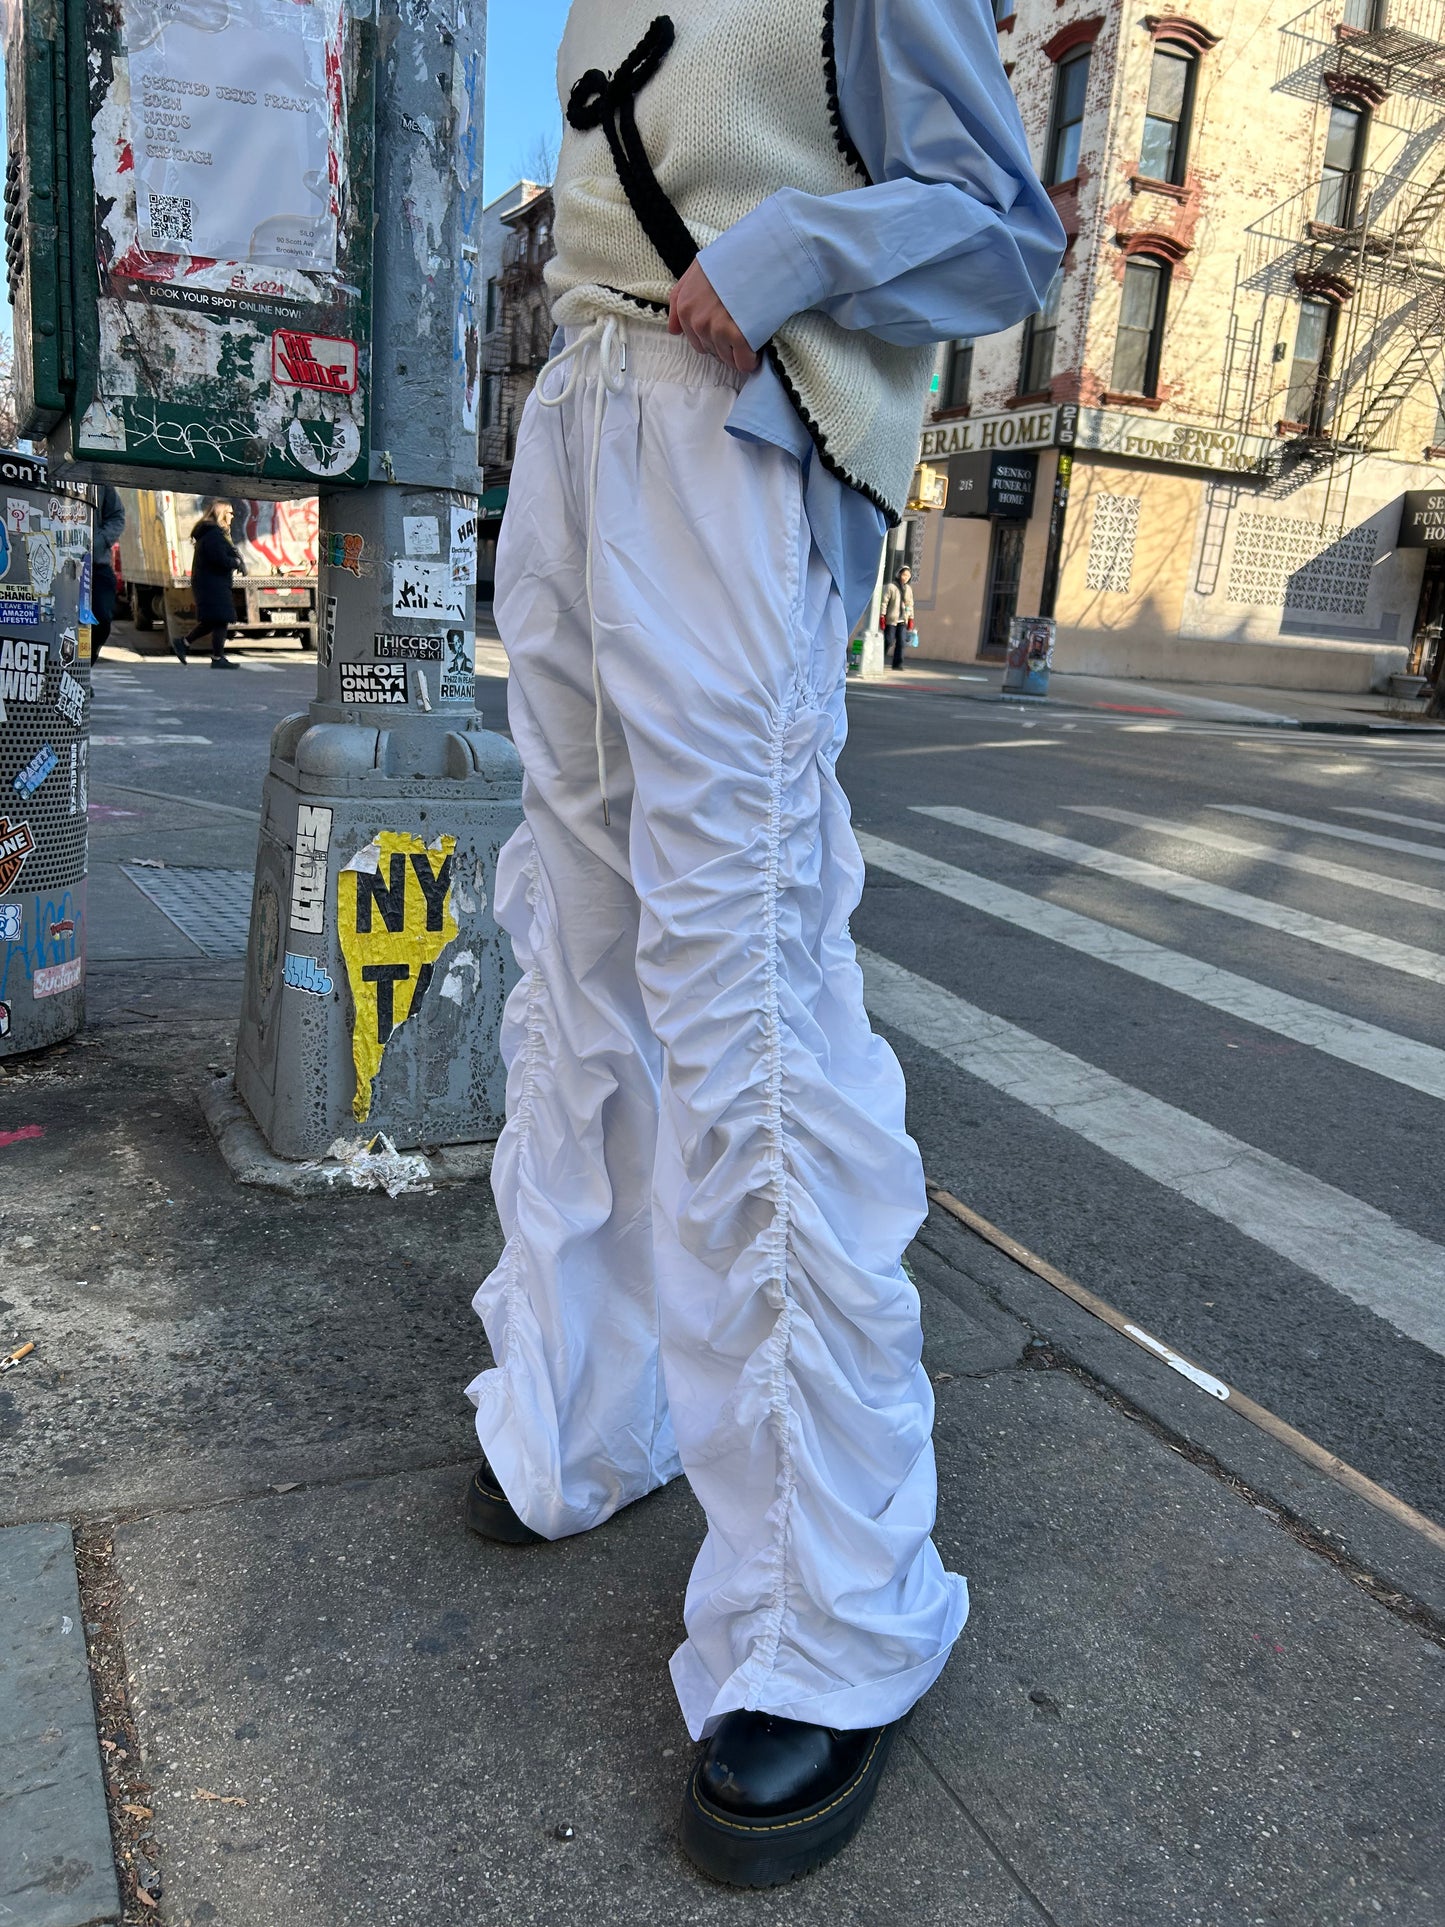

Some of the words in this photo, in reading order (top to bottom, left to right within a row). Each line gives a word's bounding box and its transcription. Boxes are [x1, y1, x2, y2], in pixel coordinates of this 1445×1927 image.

[216, 86, 257, 105] JESUS
[162, 214, 180, 224] DICE
[276, 236, 285, 244] 90
[286, 237, 302, 246] Scott
[149, 286, 180, 300] BOOK
[181, 291, 209, 305] YOUR
[210, 296, 238, 309] SPOT
[238, 300, 273, 315] ONLINE
[278, 333, 317, 362] THE
[1059, 406, 1077, 443] 215
[921, 426, 974, 456] ERAL
[980, 413, 1053, 449] HOME
[1172, 426, 1236, 451] SENKO
[1125, 436, 1216, 466] FUNERAL
[996, 465, 1032, 480] SENKO
[959, 480, 974, 492] 215
[992, 478, 1032, 493] FUNERAL
[998, 492, 1025, 506] HOME
[1413, 511, 1445, 526] FUN
[1424, 526, 1445, 541] HO
[0, 602, 22, 610] LEAVE
[2, 609, 34, 618] AMAZON
[0, 616, 38, 625] LIFESTYLE
[382, 648, 442, 659] DREWSKI
[341, 664, 405, 676] INFOE
[342, 677, 405, 690] ONLY1
[343, 691, 406, 703] BRUHA
[356, 853, 454, 934] NY
